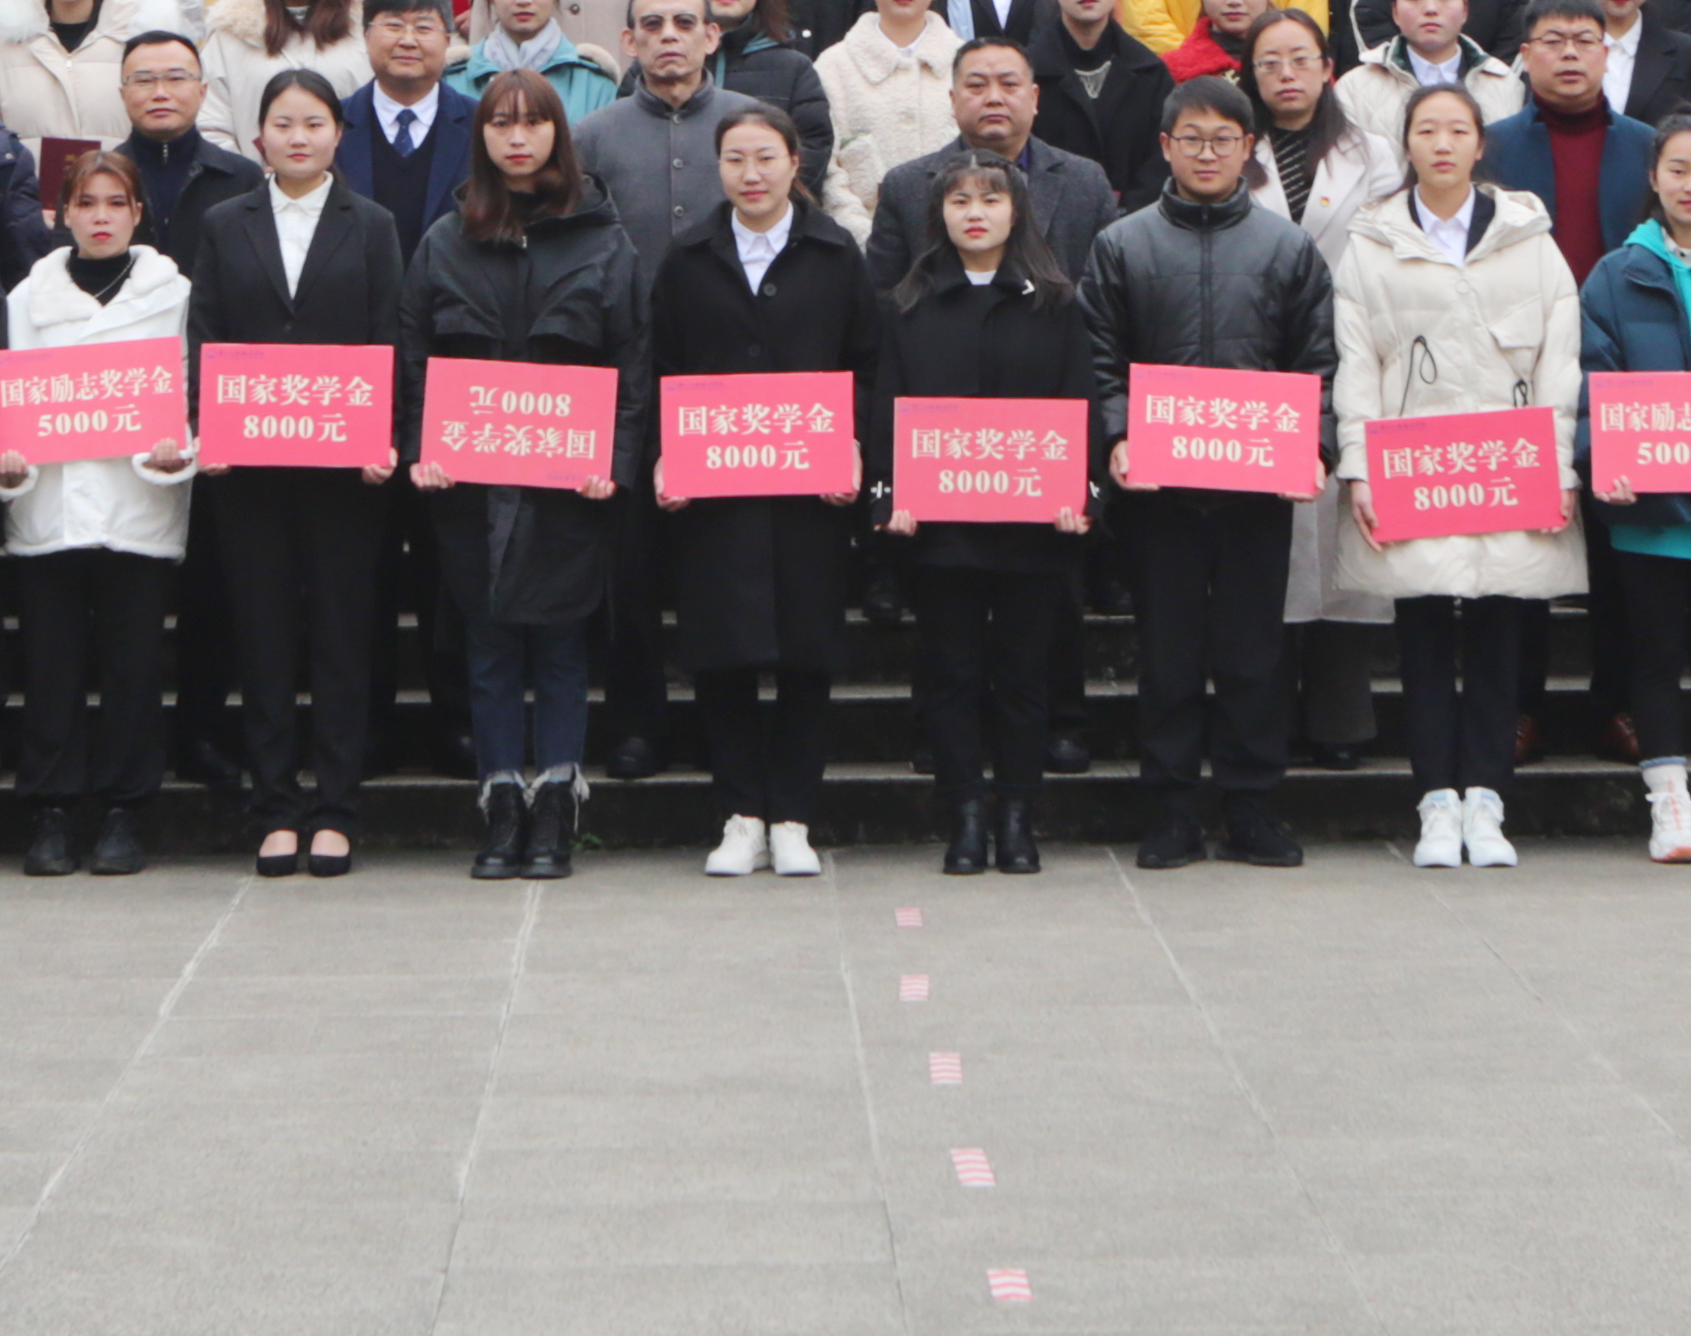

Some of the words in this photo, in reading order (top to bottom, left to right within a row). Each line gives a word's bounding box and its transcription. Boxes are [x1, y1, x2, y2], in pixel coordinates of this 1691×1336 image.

[0, 366, 174, 408] 国家励志奖学金
[217, 374, 373, 406] 国家奖学金
[469, 385, 572, 417] 8000元
[38, 403, 142, 437] 5000元
[243, 413, 347, 442] 8000元
[678, 403, 834, 436] 国家奖学金
[1146, 394, 1301, 433] 国家奖学金
[441, 420, 596, 460] 国家奖学金
[706, 440, 810, 470] 8000元
[912, 428, 1068, 460] 国家奖学金
[1171, 435, 1275, 467] 8000元
[1382, 437, 1540, 479] 国家奖学金
[938, 467, 1042, 497] 8000元
[1414, 476, 1518, 510] 8000元
